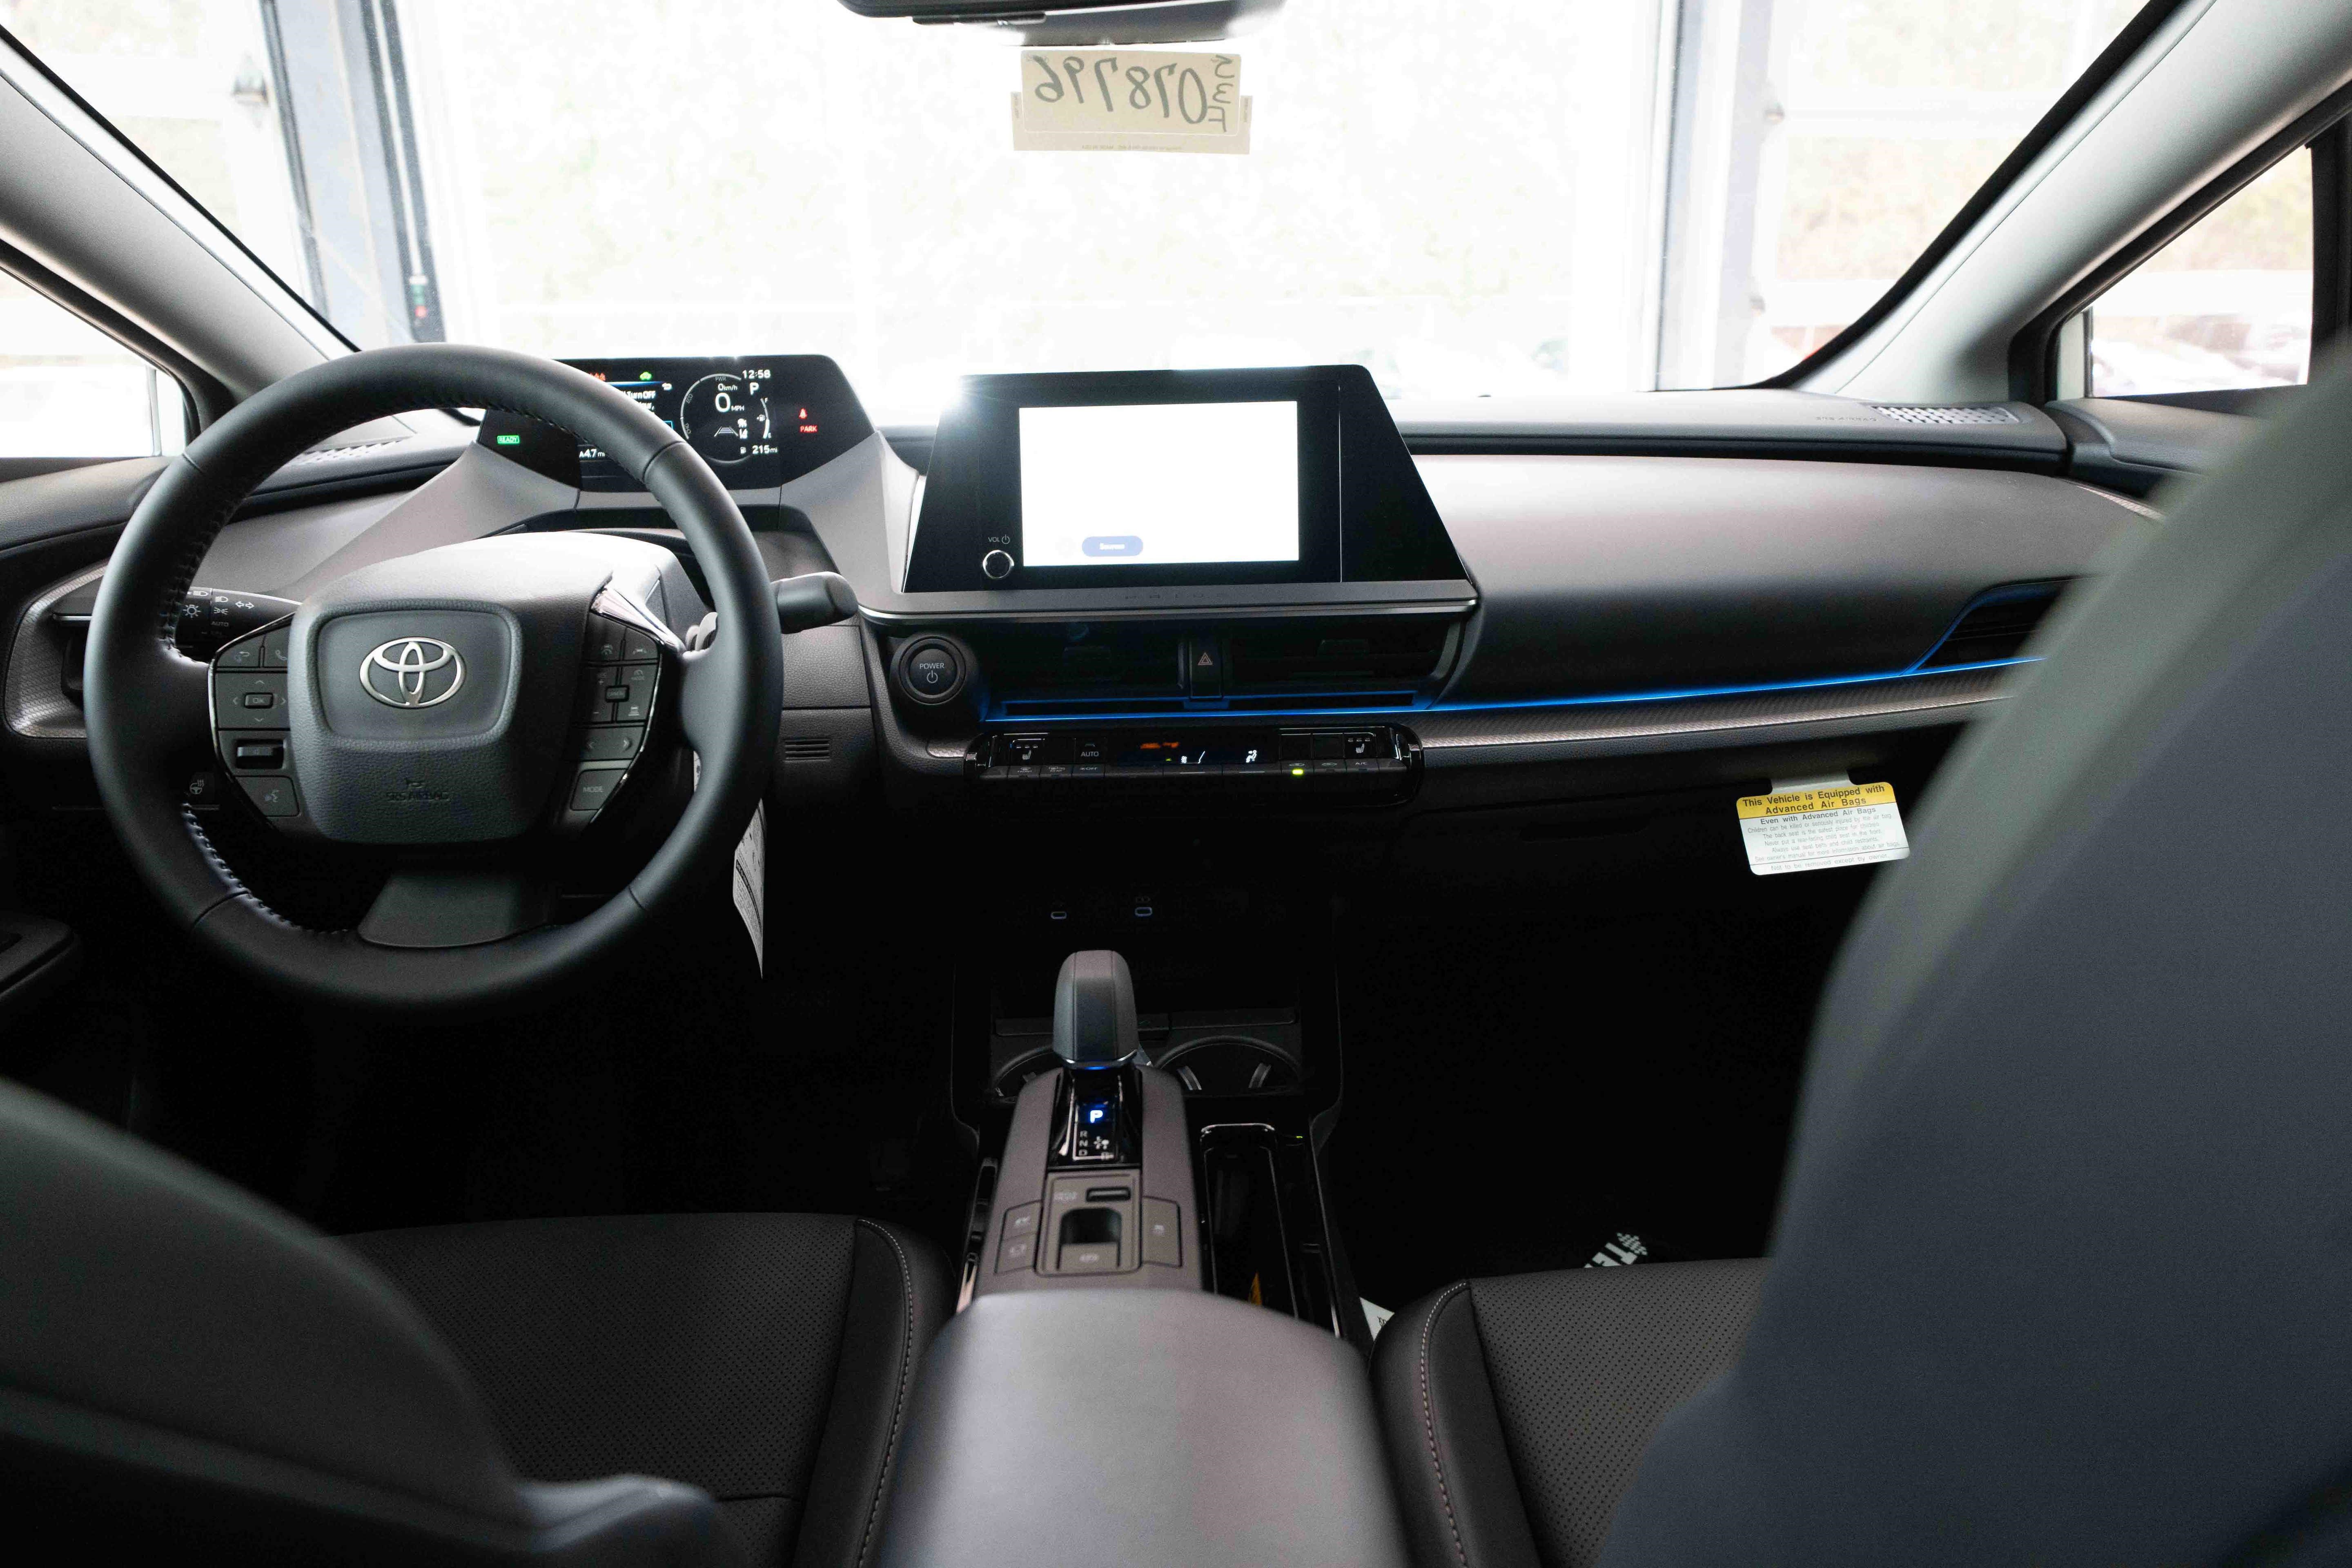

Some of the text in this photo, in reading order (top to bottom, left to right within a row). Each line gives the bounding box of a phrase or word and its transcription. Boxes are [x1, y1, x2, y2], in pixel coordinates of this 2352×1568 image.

[743, 370, 771, 379] 12:58
[750, 383, 759, 395] P
[715, 393, 731, 412] 0
[1743, 798, 1762, 807] This
[1767, 794, 1800, 804] Vehicle
[1818, 788, 1860, 799] Equipped
[1866, 785, 1884, 793] with
[1766, 802, 1814, 814] Advanced
[1842, 797, 1866, 806] Bags
[1802, 811, 1838, 820] Advanced
[1857, 806, 1876, 815] Bags
[1090, 1110, 1102, 1123] P
